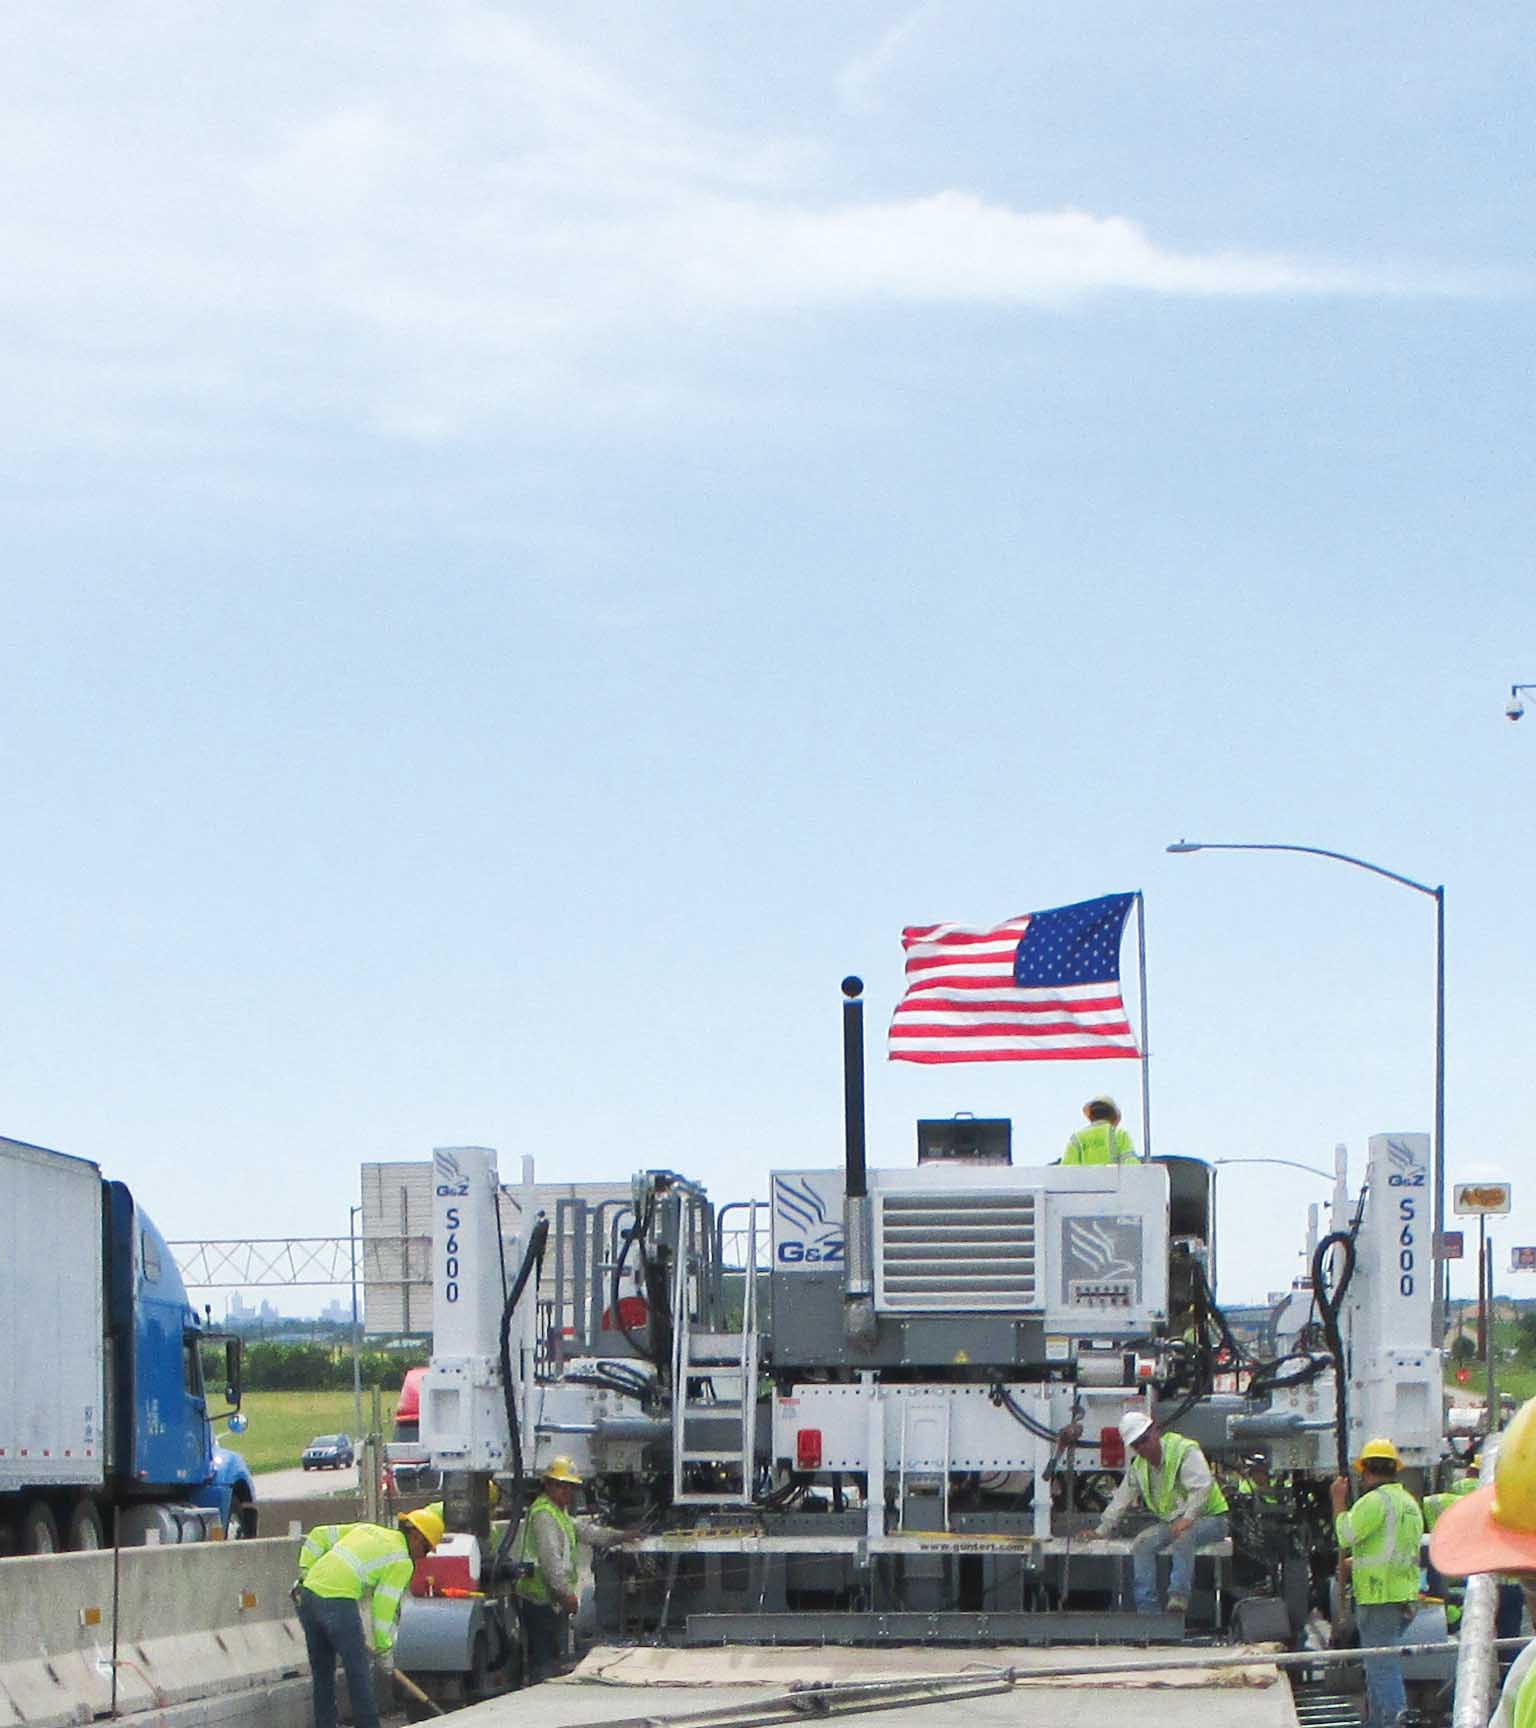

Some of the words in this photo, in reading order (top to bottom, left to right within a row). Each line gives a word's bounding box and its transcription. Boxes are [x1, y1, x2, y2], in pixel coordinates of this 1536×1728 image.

[436, 1184, 470, 1198] G&Z
[1387, 1173, 1425, 1188] G&Z
[446, 1207, 461, 1303] S600
[777, 1241, 847, 1263] G&Z
[1399, 1198, 1415, 1297] S600
